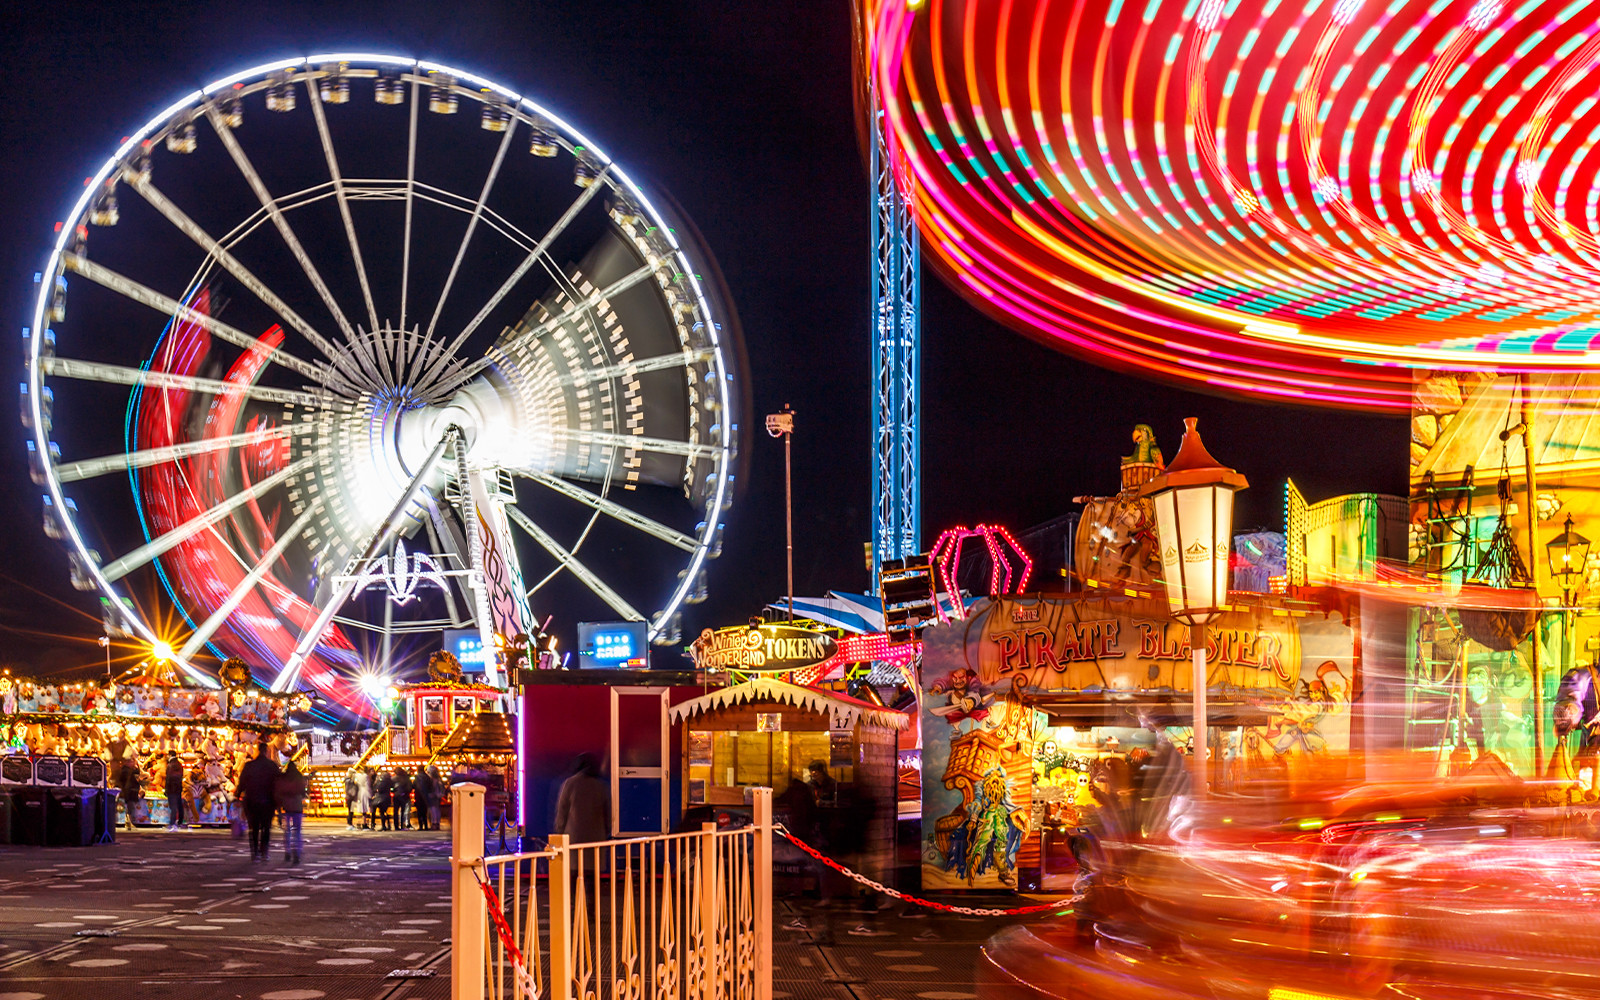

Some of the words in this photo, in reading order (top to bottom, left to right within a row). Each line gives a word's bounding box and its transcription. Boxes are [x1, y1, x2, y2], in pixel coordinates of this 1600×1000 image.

[1012, 609, 1040, 622] THE
[765, 637, 825, 660] TOKENS
[990, 619, 1125, 672] PIRATE
[1131, 618, 1290, 681] BLASTER
[835, 717, 849, 729] 17
